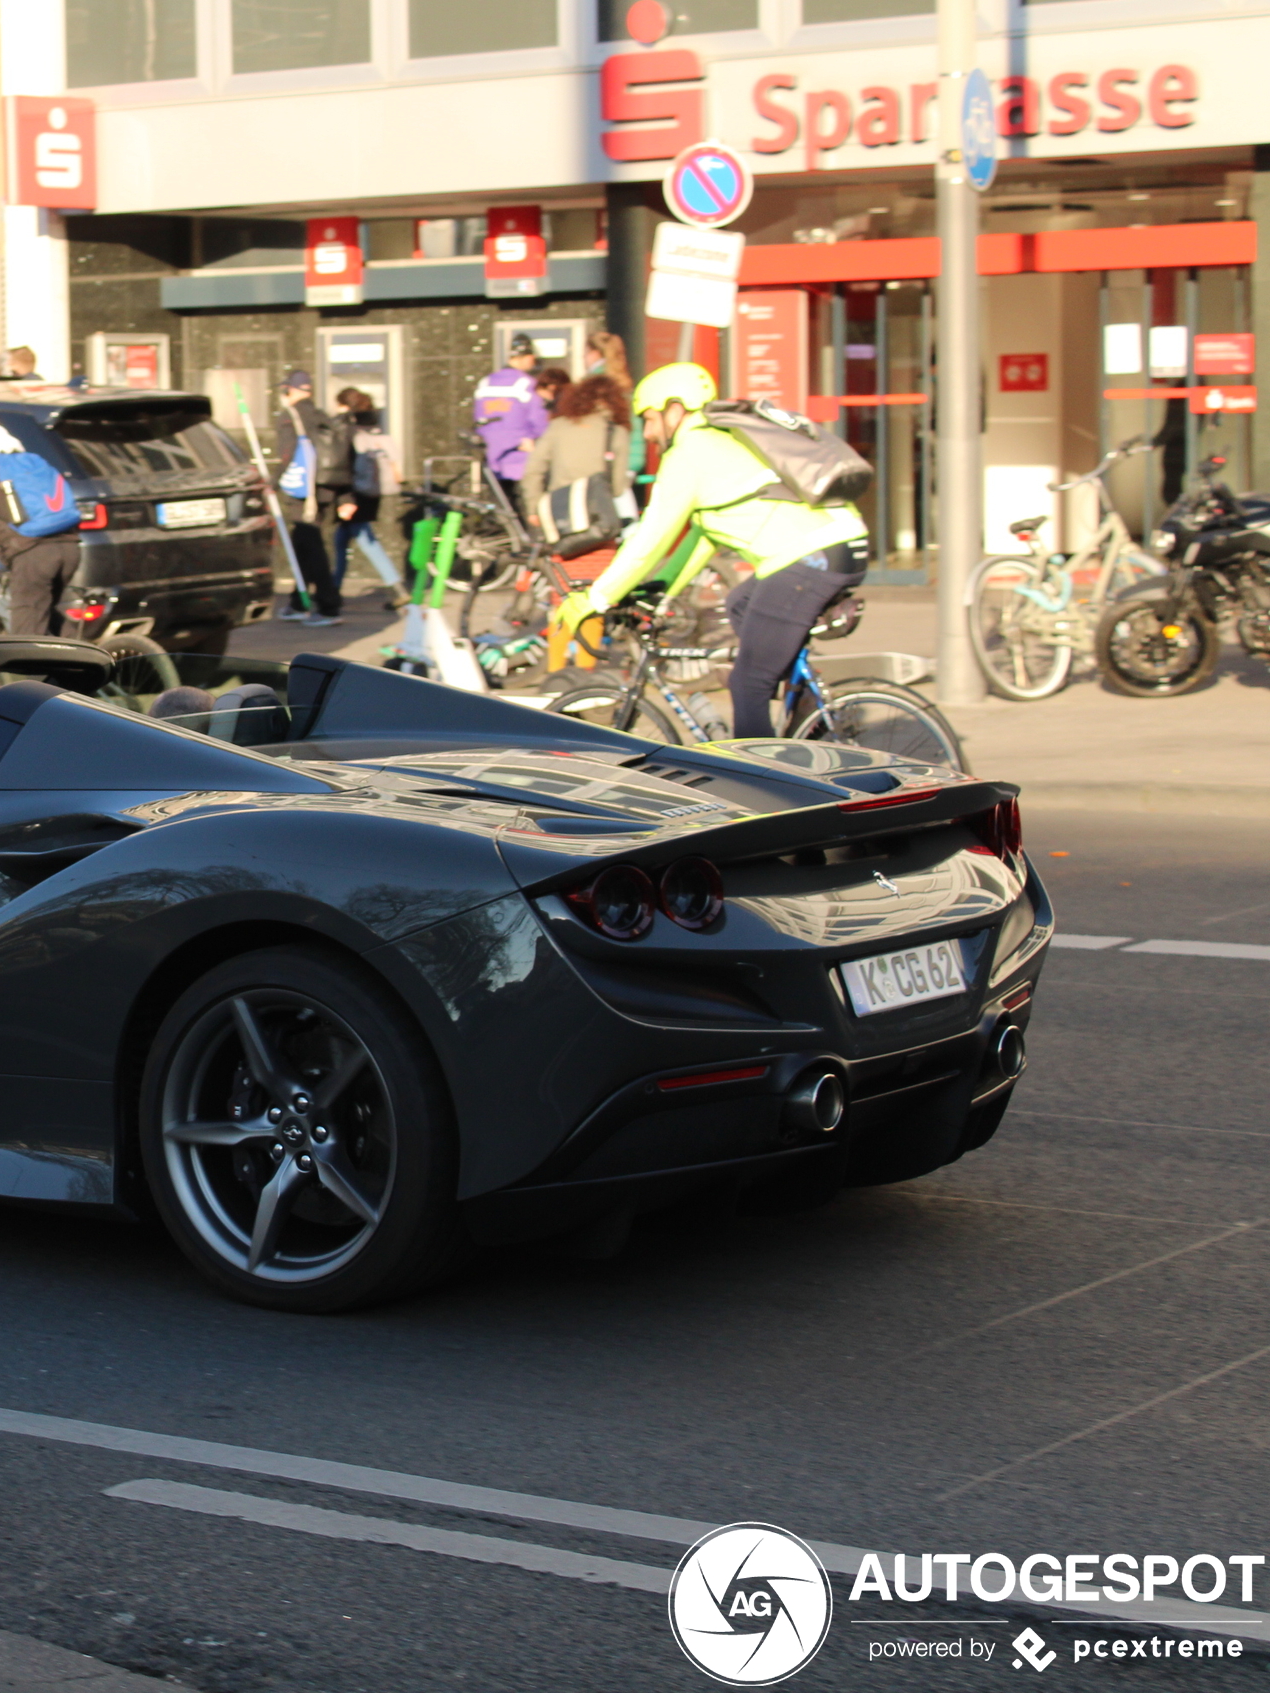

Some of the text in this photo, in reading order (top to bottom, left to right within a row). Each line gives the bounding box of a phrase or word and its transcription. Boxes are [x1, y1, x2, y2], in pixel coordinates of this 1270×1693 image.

[751, 64, 1197, 171] Sparasse
[859, 946, 961, 1005] K CG 62
